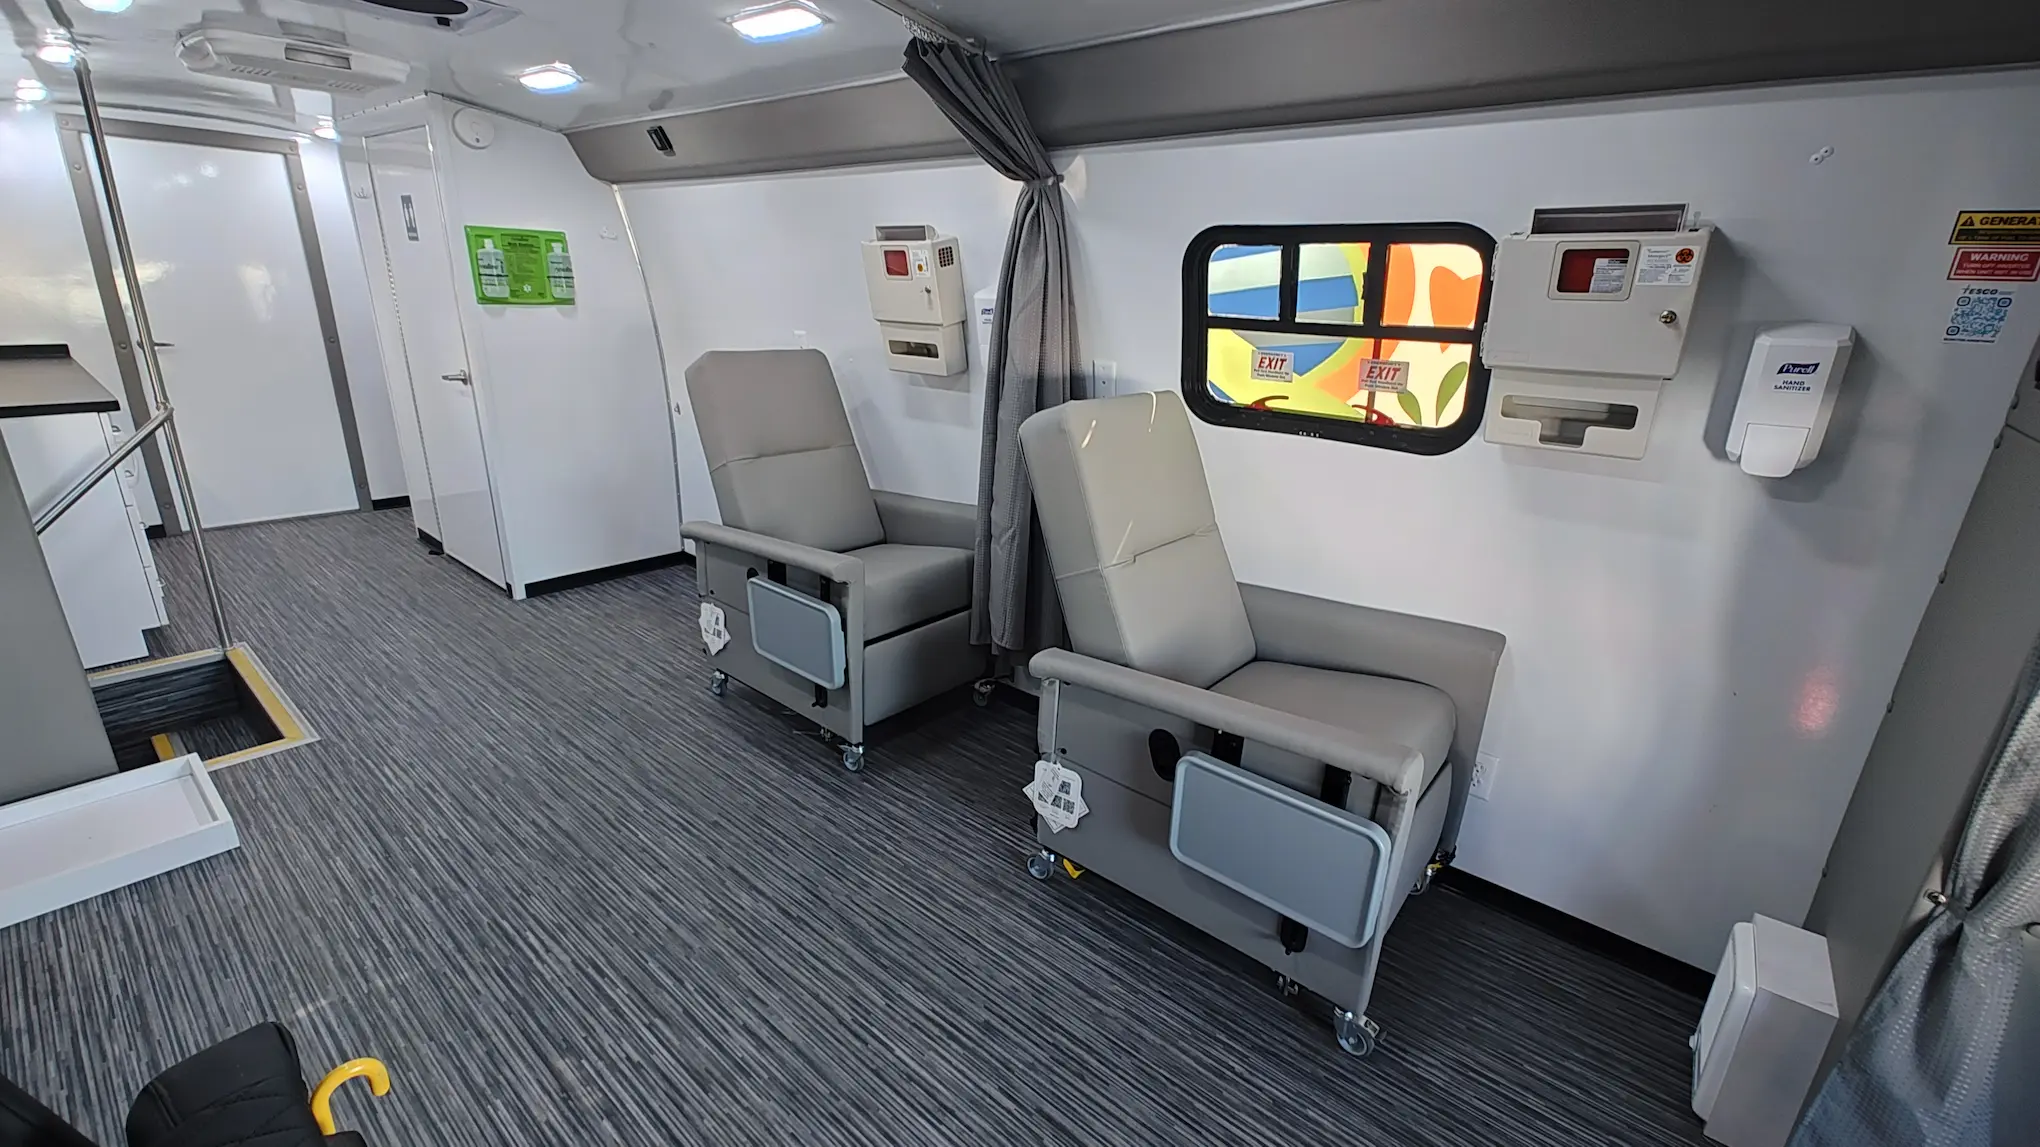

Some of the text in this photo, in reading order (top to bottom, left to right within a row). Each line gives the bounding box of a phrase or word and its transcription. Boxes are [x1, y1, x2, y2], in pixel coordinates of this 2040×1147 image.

[1970, 253, 2029, 261] WARNING
[1258, 356, 1287, 371] EXIT
[1366, 365, 1401, 381] EXIT
